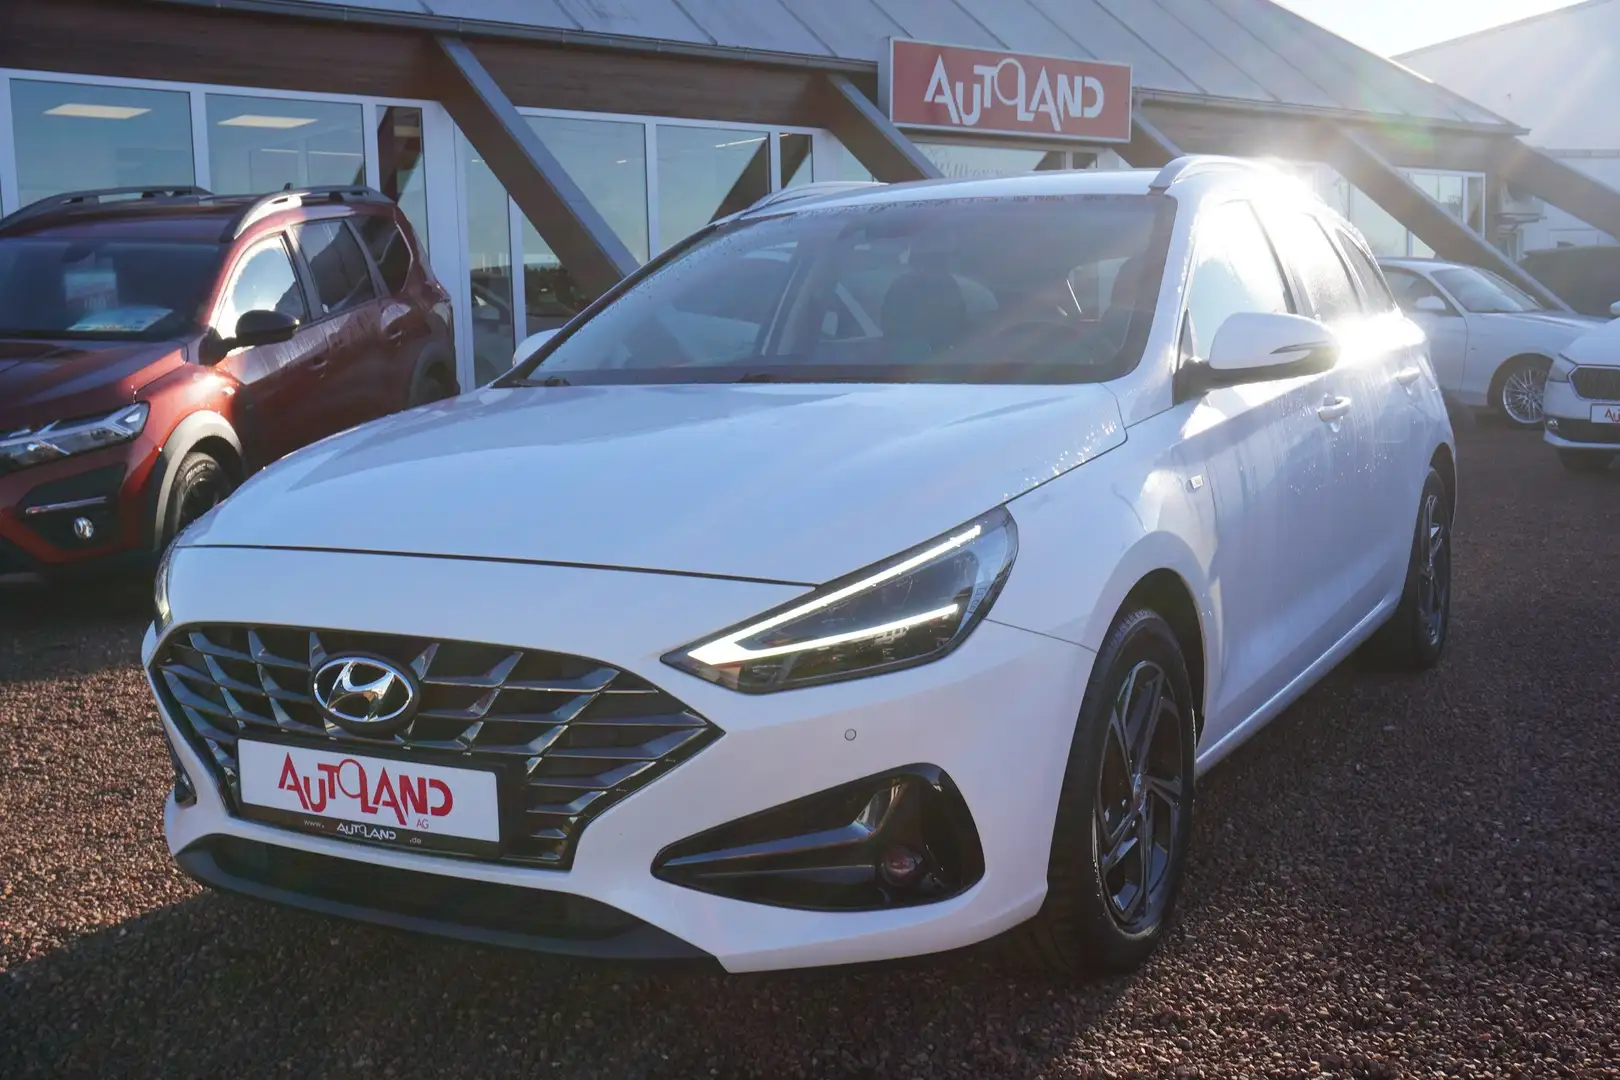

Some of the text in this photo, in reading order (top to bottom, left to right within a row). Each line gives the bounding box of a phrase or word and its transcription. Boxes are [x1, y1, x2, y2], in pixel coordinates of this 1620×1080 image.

[924, 54, 1104, 131] AUTOLAND
[278, 752, 453, 825] AUTOLAND
[336, 822, 397, 841] AUTOLAND
[416, 818, 429, 829] AG
